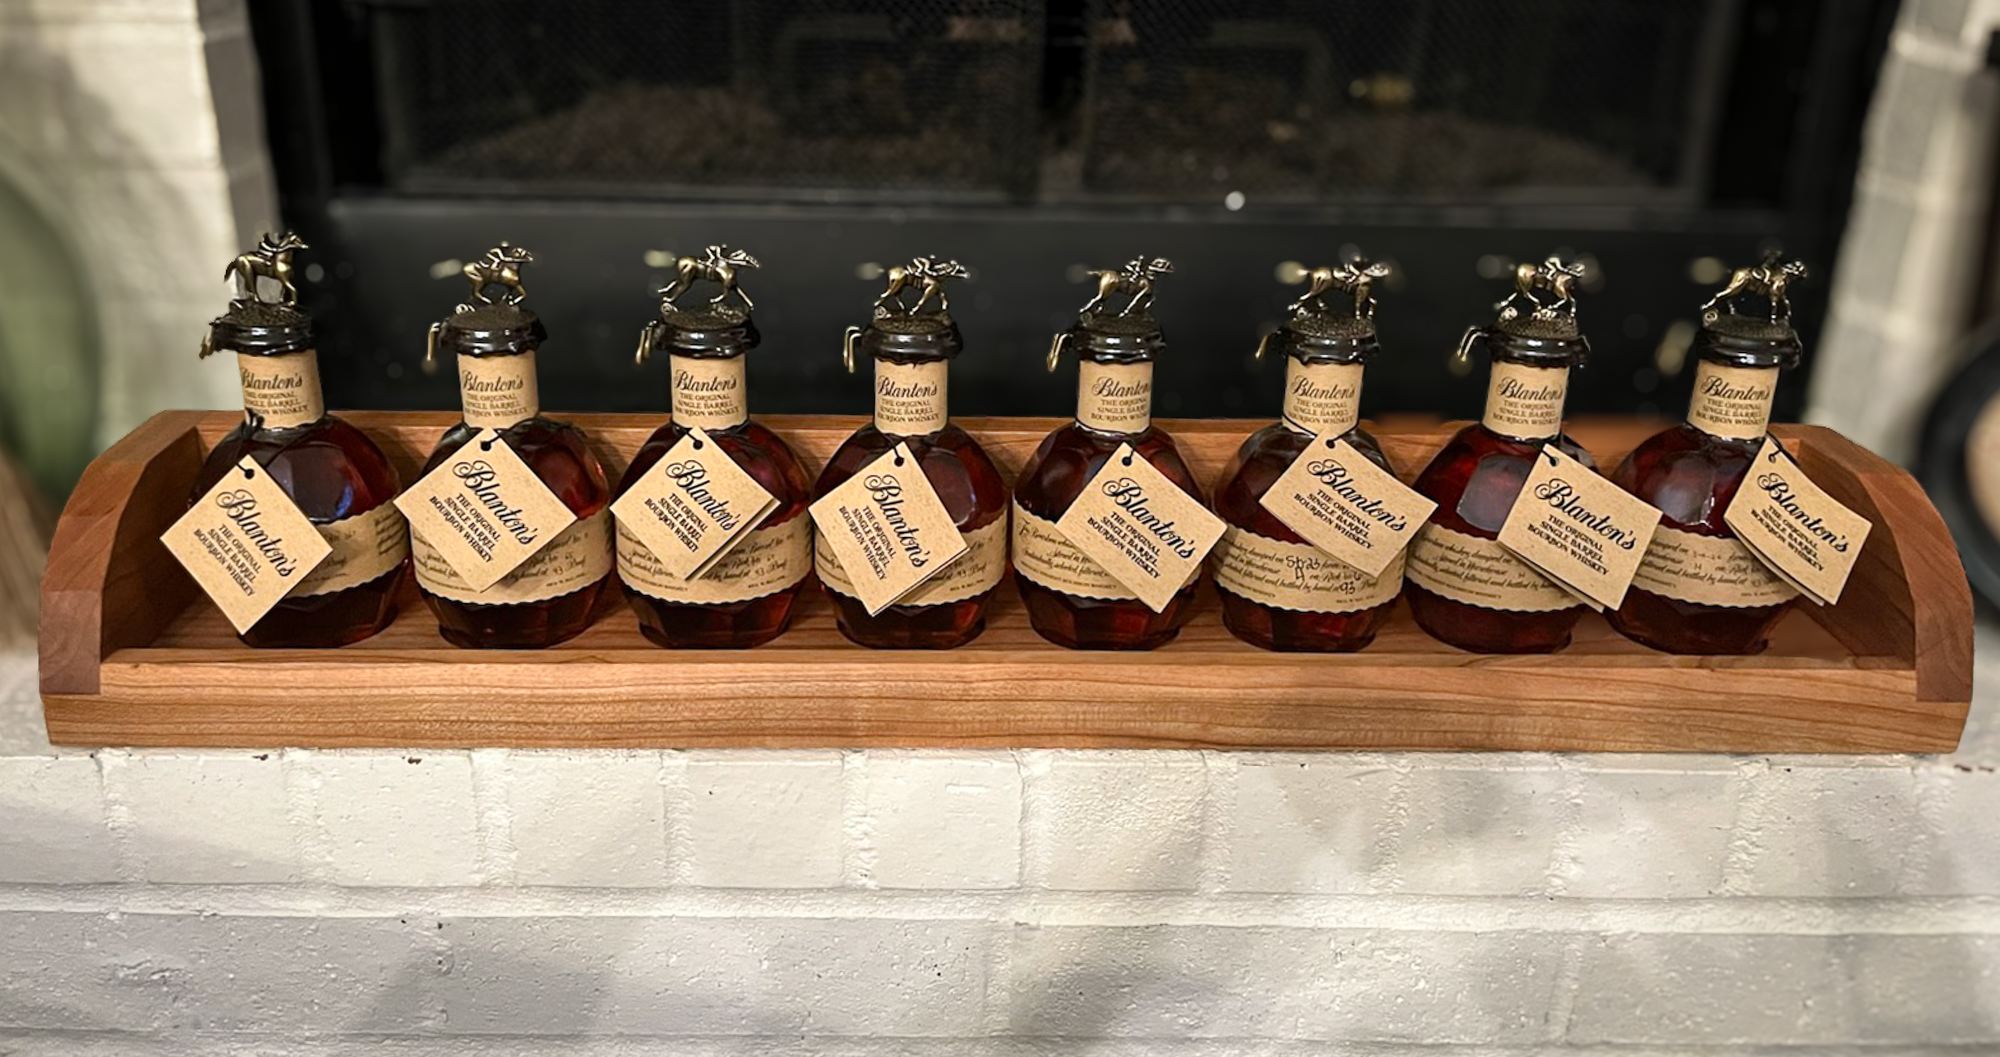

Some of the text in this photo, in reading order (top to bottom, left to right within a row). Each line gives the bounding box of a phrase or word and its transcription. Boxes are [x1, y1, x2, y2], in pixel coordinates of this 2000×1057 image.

[462, 369, 524, 392] Blanton's
[675, 368, 737, 391] Blanton's
[877, 375, 937, 398] Blanton's
[1290, 374, 1355, 399] Blanton's
[1701, 375, 1770, 400] Blanton's
[452, 460, 538, 545] Blanton's
[456, 492, 502, 543] THE ORIGINAL
[658, 498, 702, 542] SINGLE BARREL
[665, 459, 741, 531] Blanton's
[669, 492, 709, 533] THE ORIGINAL
[863, 474, 931, 568] Blanton's
[1101, 477, 1196, 559] Blanton's
[1293, 493, 1374, 550] BOURBON WHISKEY
[1306, 458, 1408, 532] Blanton's
[1306, 493, 1370, 540] SINGLE BARREL
[1317, 489, 1371, 530] THE ORIGINAL
[1534, 478, 1637, 550] Blanton's
[1757, 472, 1849, 553] Blanton's
[216, 489, 297, 577] Blanton's
[218, 523, 262, 574] THE ORIGINAL
[429, 496, 464, 534] BOURBON
[463, 532, 493, 563] WHISKEY
[444, 497, 496, 551] SINGLE BARREL
[644, 498, 675, 531] BOURBON
[674, 528, 700, 553] WHISKEY
[838, 506, 887, 581] BOURBON WHISKEY
[851, 507, 890, 569] SINGLE BARREL
[862, 505, 897, 559] THE ORIGINAL
[1087, 516, 1125, 551] BOURBON
[1125, 548, 1161, 579] WHISKEY
[1100, 516, 1128, 541] SINGLE
[1127, 538, 1158, 568] BARREL
[1110, 511, 1161, 557] THE ORIGINAL
[1527, 523, 1609, 576] BOURBON WHISKEY
[1540, 520, 1604, 564] SINGLE BARREL
[1548, 515, 1604, 553] THE ORIGINAL
[1750, 509, 1786, 543] BOURBON
[1787, 540, 1824, 572] WHISKEY
[1761, 508, 1820, 560] SINGLE BARREL
[1768, 505, 1820, 551] THE ORIGINAL
[193, 529, 256, 597] BOURBON WHISKEY
[207, 528, 257, 583] SINGLE BARREL
